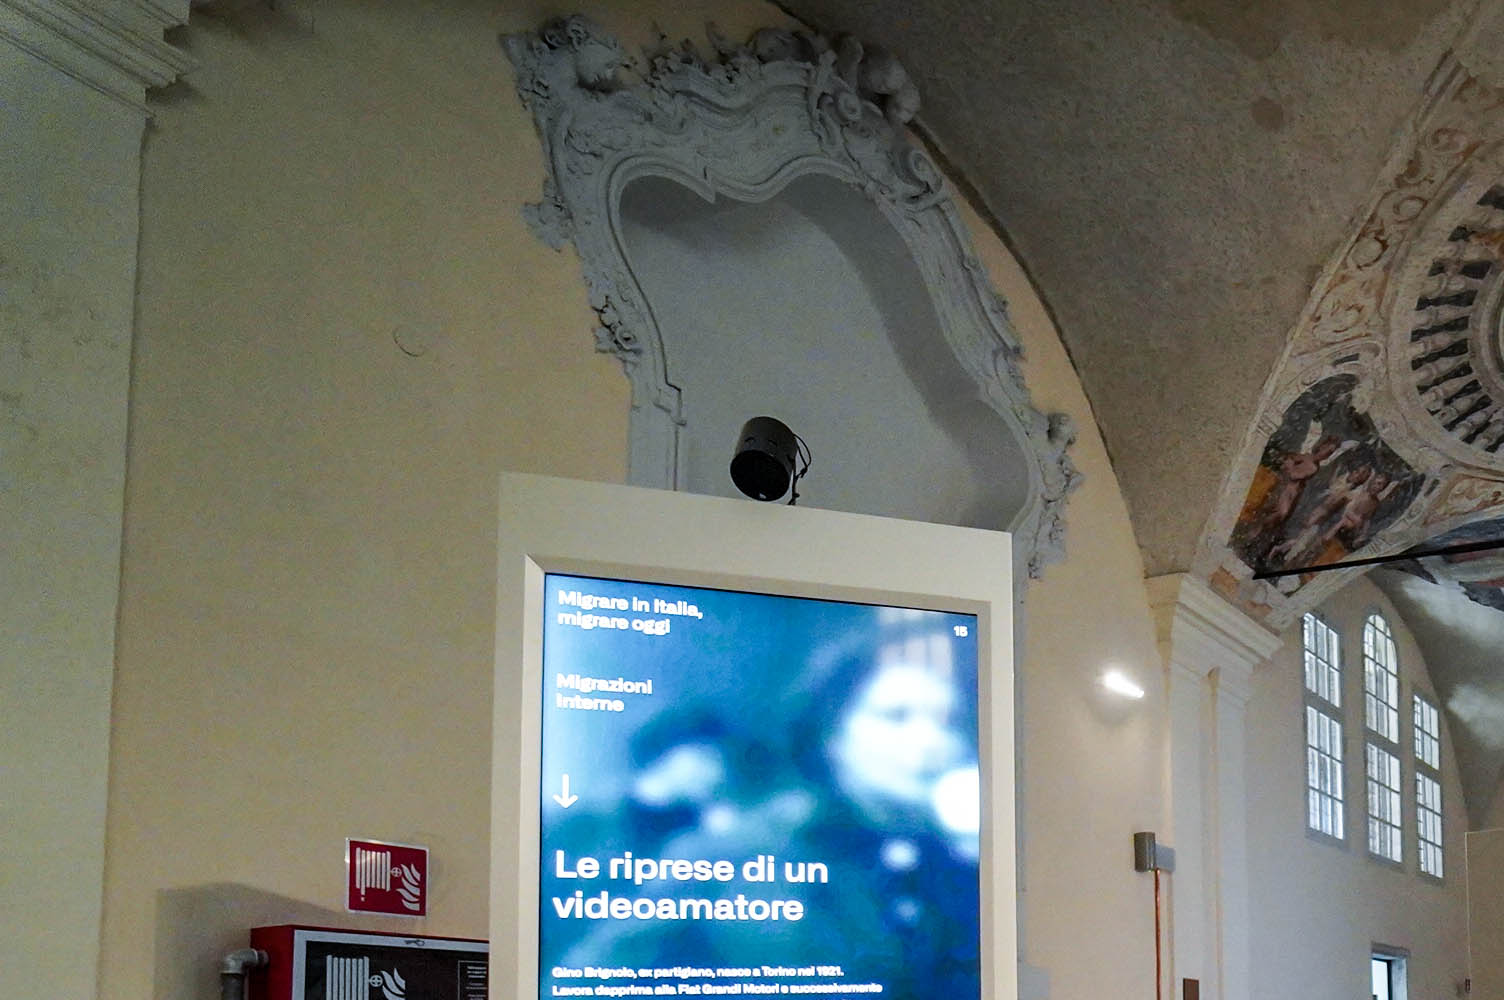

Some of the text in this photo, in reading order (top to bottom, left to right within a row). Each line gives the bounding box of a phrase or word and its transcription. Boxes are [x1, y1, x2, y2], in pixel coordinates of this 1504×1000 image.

[558, 590, 703, 619] Migrare in Italia,
[558, 611, 670, 636] migrare oggi
[954, 626, 968, 637] 15
[556, 673, 652, 694] Migrazioni
[554, 850, 828, 885] Le riprese di un
[552, 891, 804, 922] videoamatore
[638, 969, 652, 977] ex
